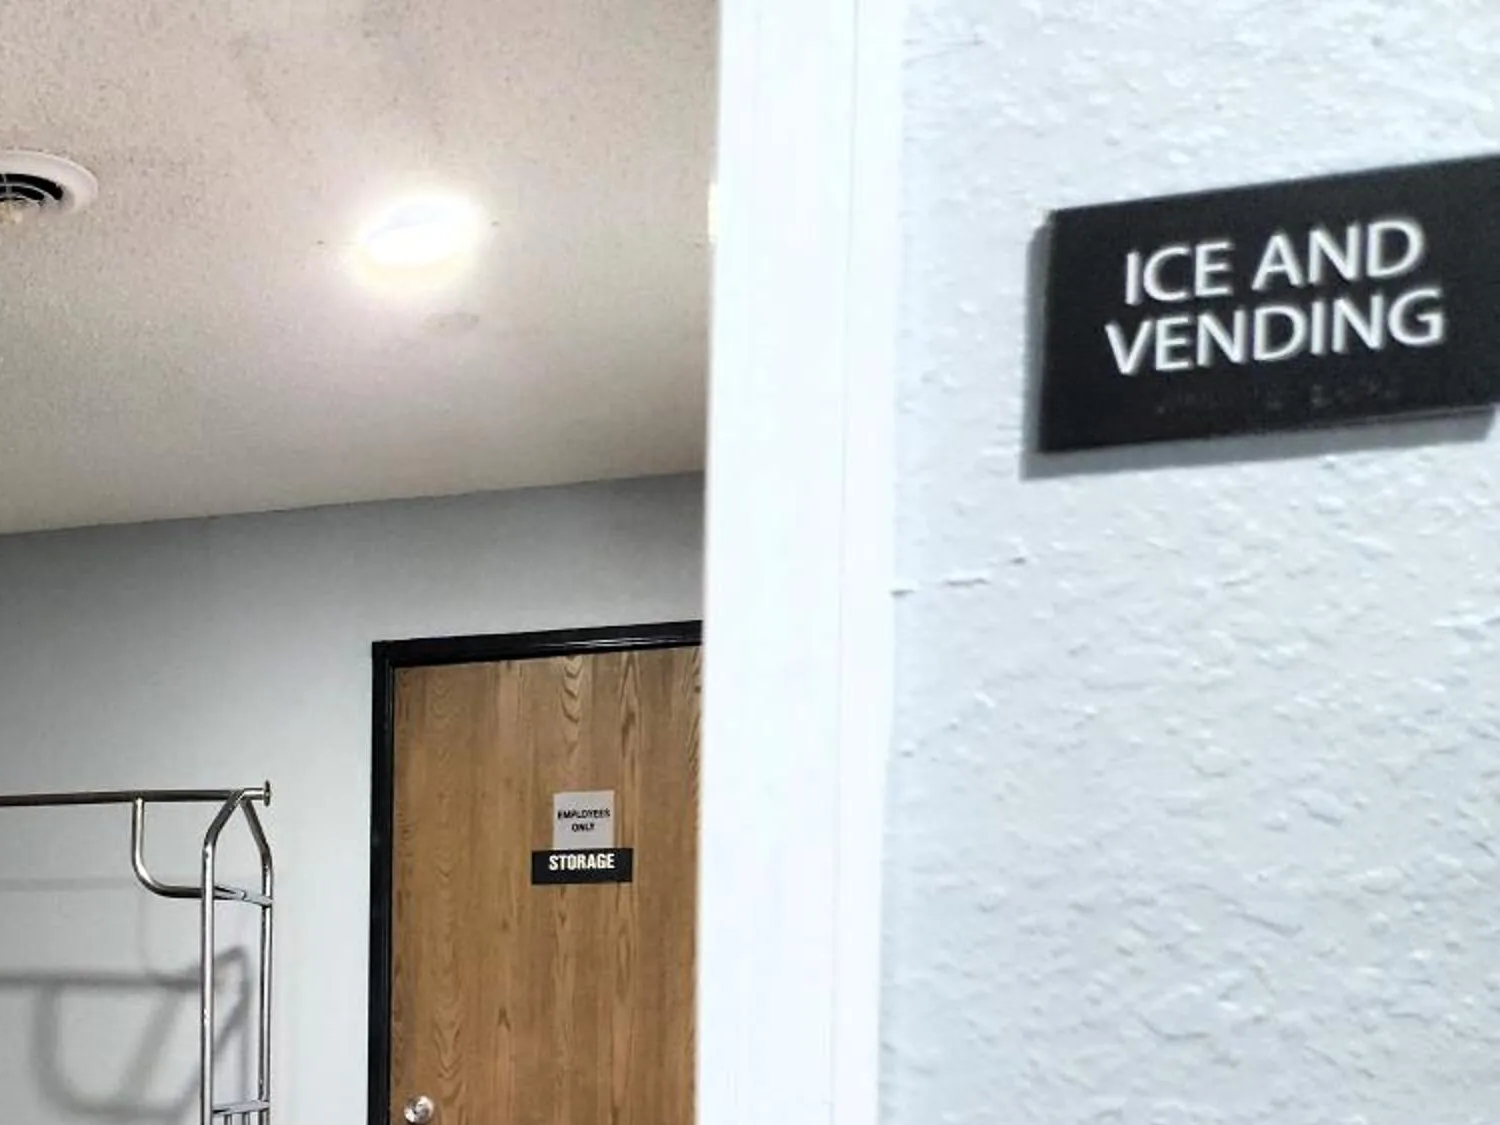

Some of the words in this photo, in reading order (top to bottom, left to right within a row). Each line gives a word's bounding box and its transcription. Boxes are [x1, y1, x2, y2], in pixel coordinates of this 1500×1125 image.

[1124, 239, 1235, 306] ICE
[1251, 219, 1426, 291] AND
[1105, 287, 1446, 376] VENDING
[557, 808, 611, 820] EMPLOYEES
[571, 823, 595, 832] ONLY
[548, 853, 616, 871] STORAGE
